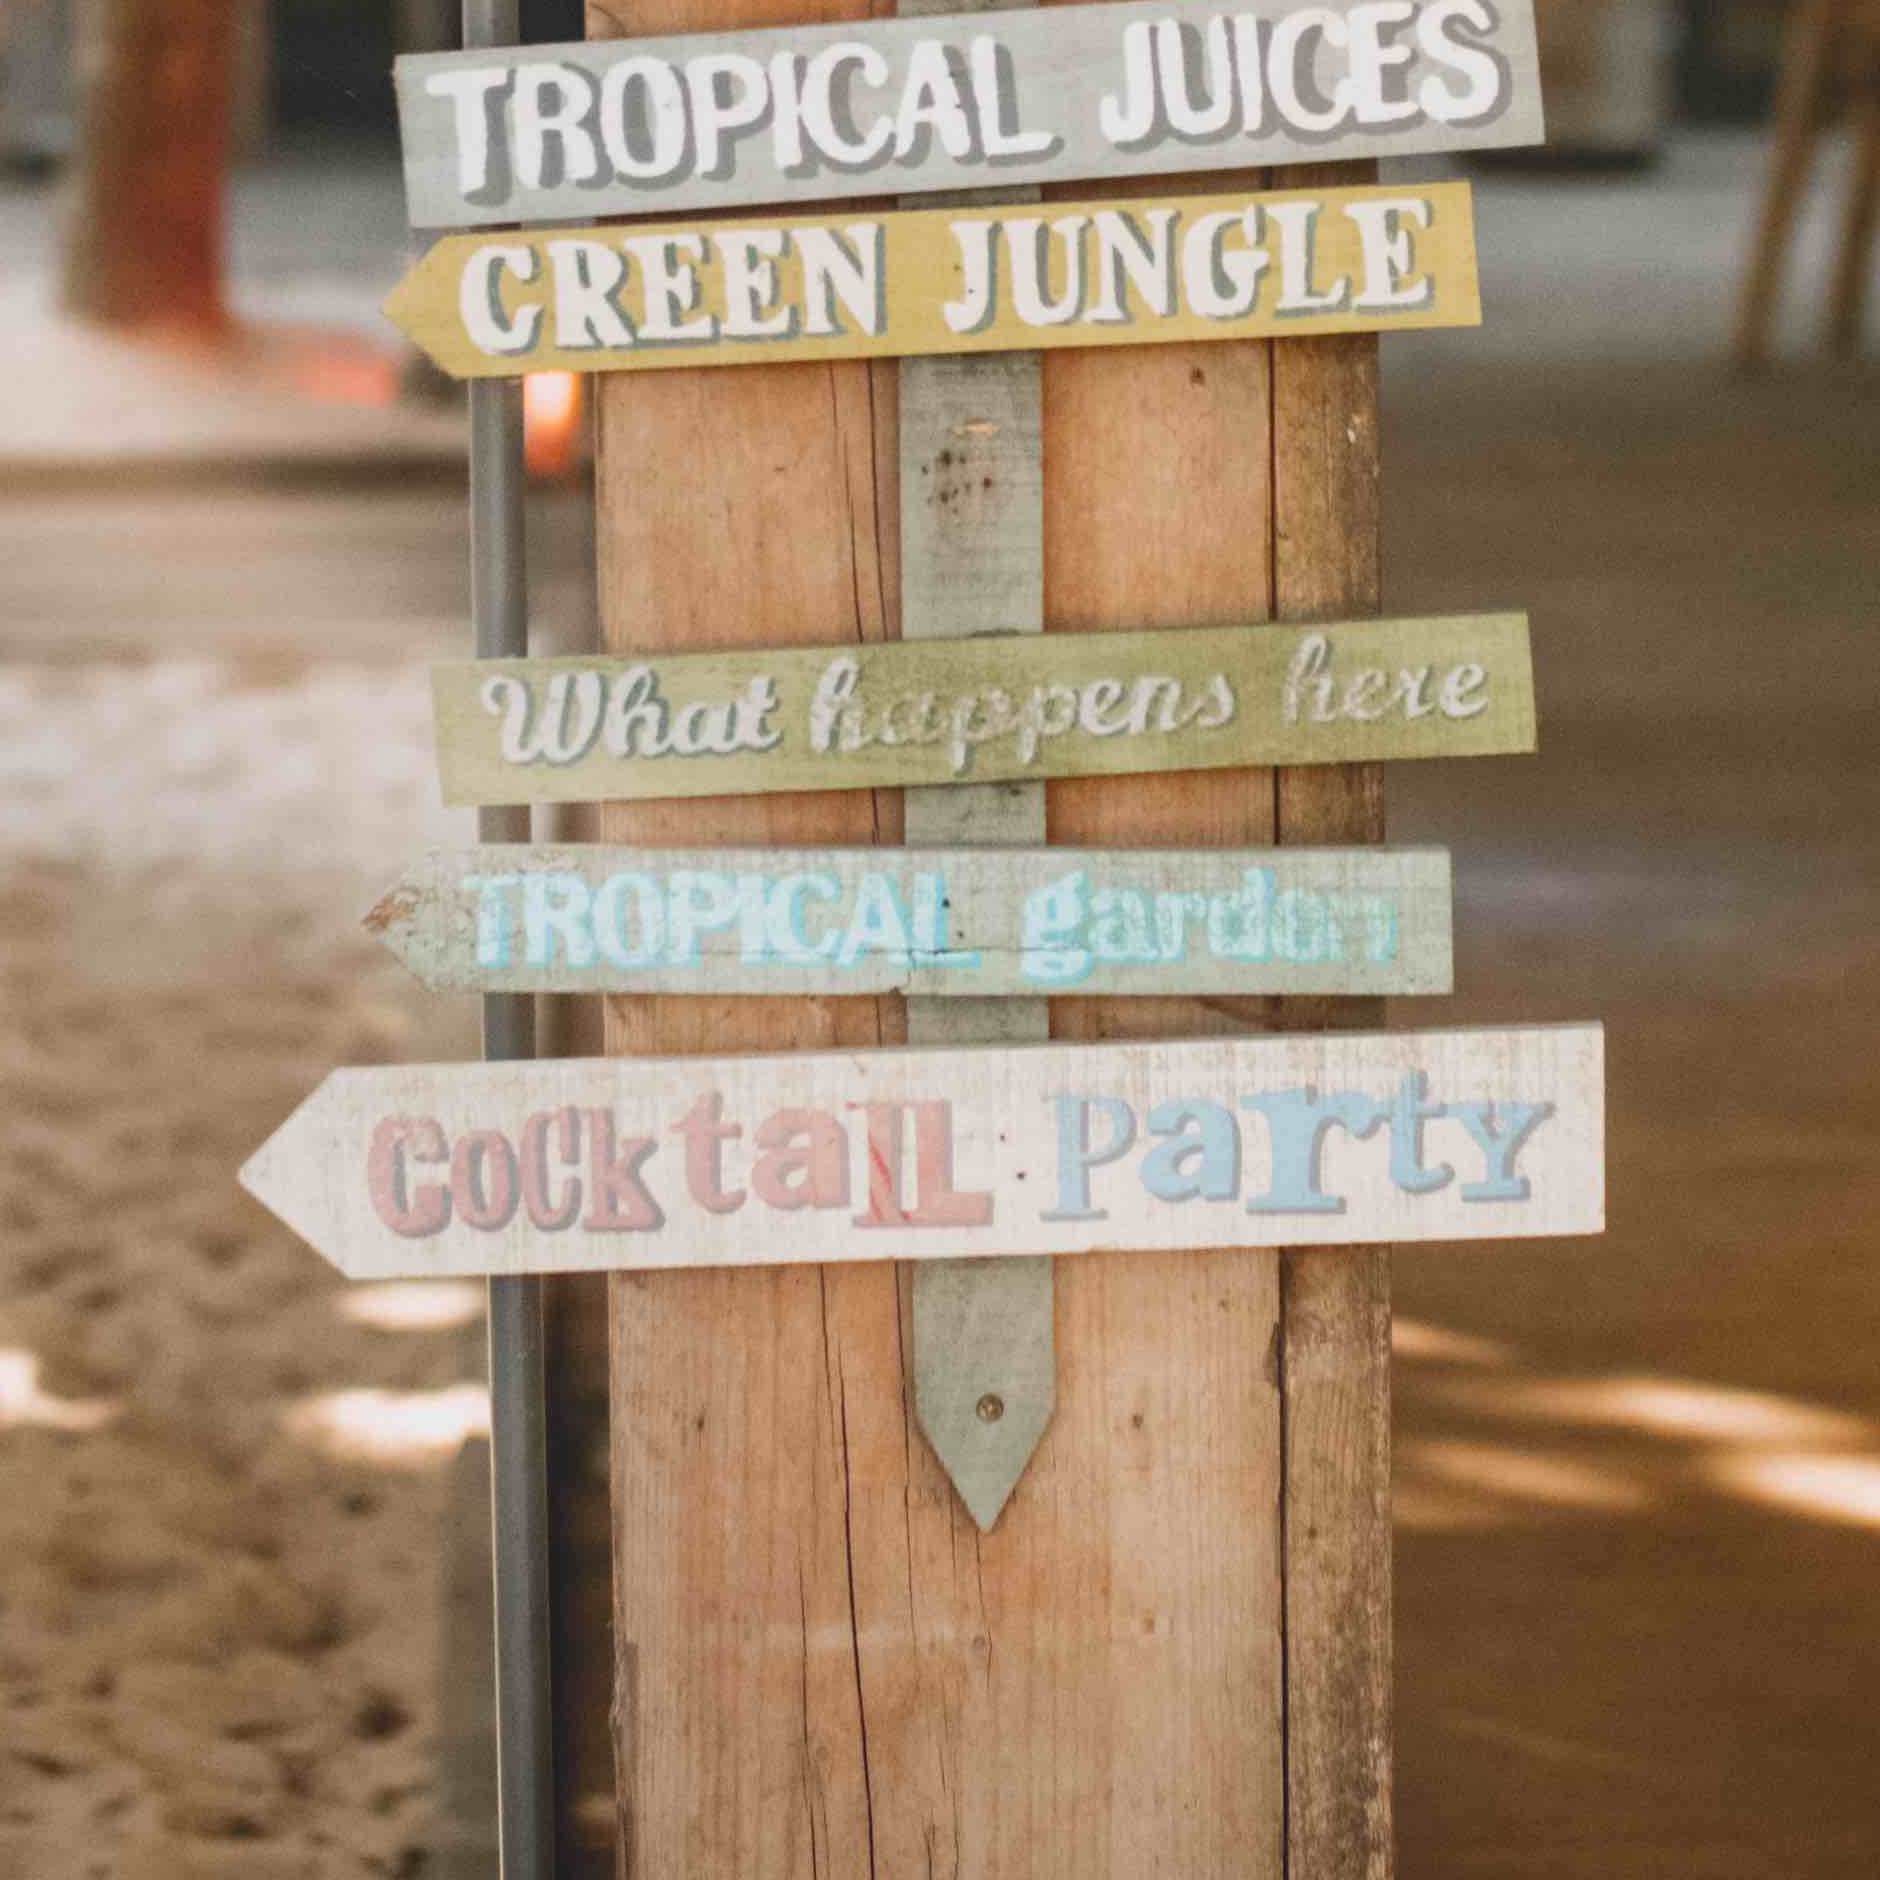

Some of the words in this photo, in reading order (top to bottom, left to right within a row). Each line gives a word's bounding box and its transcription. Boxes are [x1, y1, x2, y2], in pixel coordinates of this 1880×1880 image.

[426, 36, 1059, 203] TROPICAL
[942, 194, 1438, 332] JUNGLE
[480, 663, 783, 767] What
[808, 654, 1236, 772] happens
[1278, 633, 1491, 723] here
[460, 869, 982, 969] TROPICAL
[1018, 867, 1399, 983] garden
